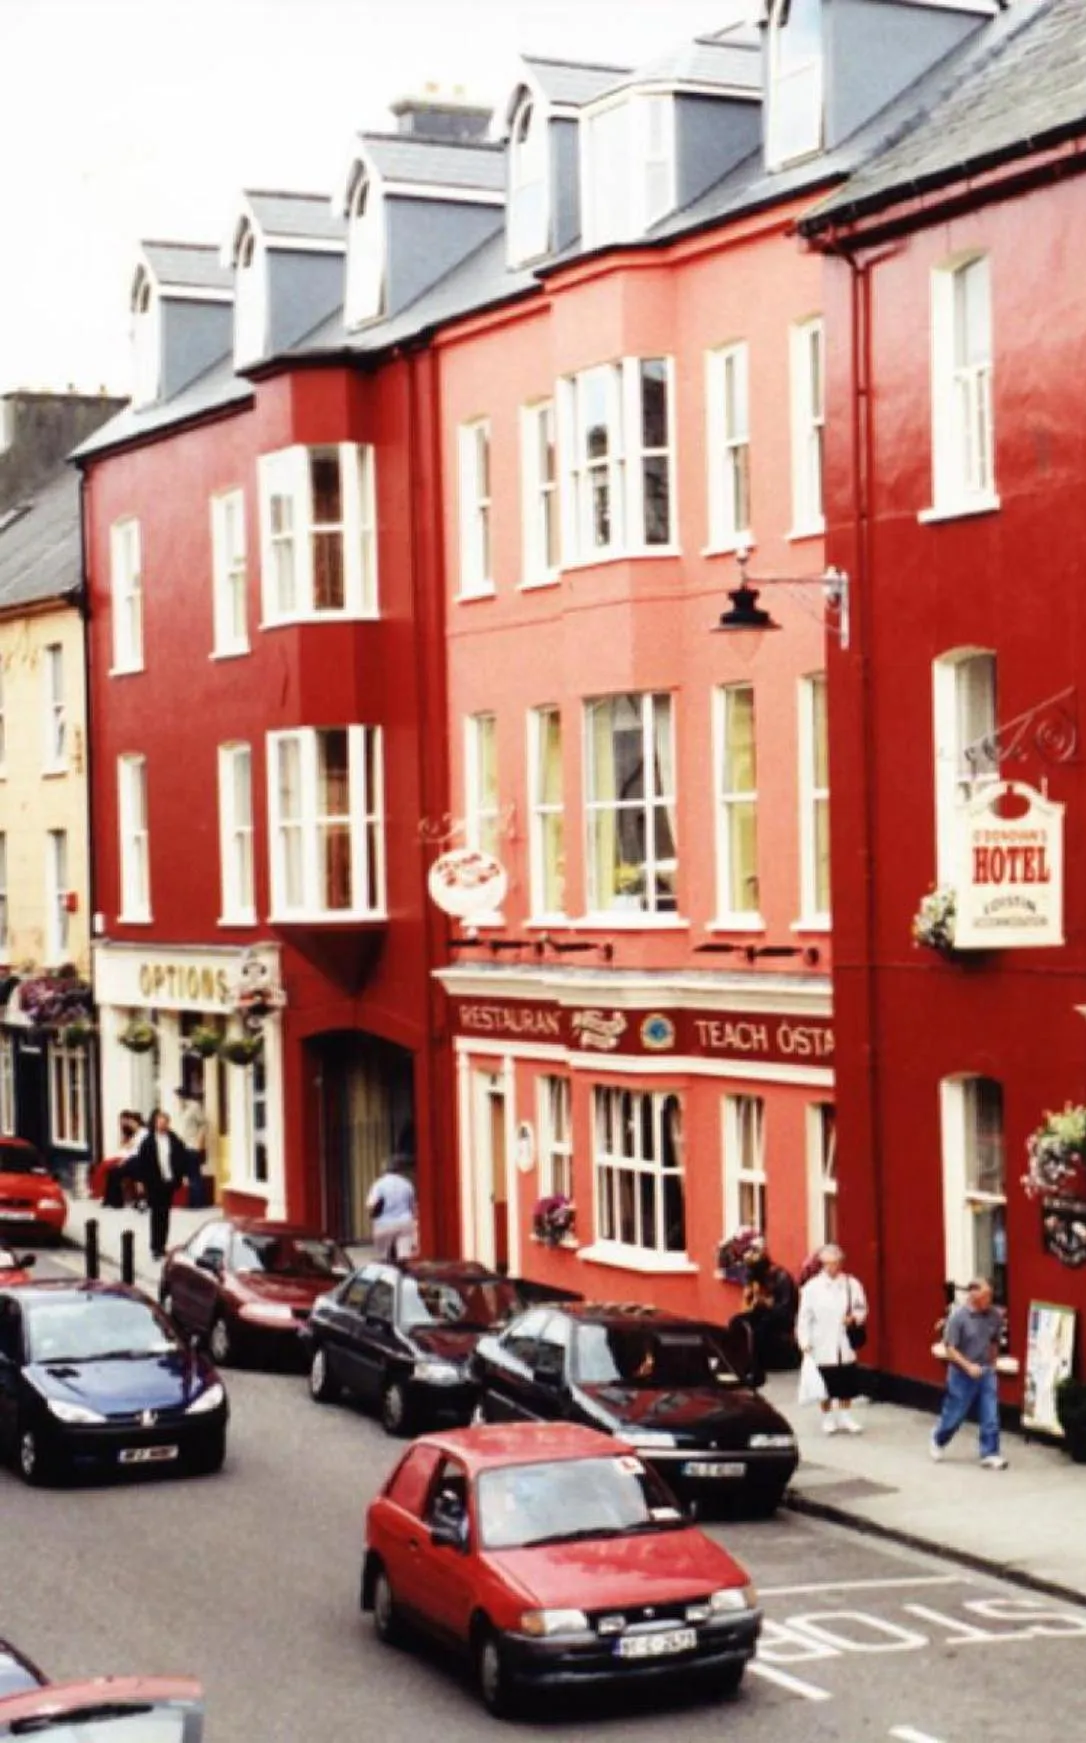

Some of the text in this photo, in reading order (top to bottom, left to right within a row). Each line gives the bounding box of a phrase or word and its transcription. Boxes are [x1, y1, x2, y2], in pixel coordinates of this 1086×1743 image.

[972, 845, 1051, 885] HOTEL
[139, 963, 230, 1004] OPTIONS
[694, 1020, 768, 1052] TEACH
